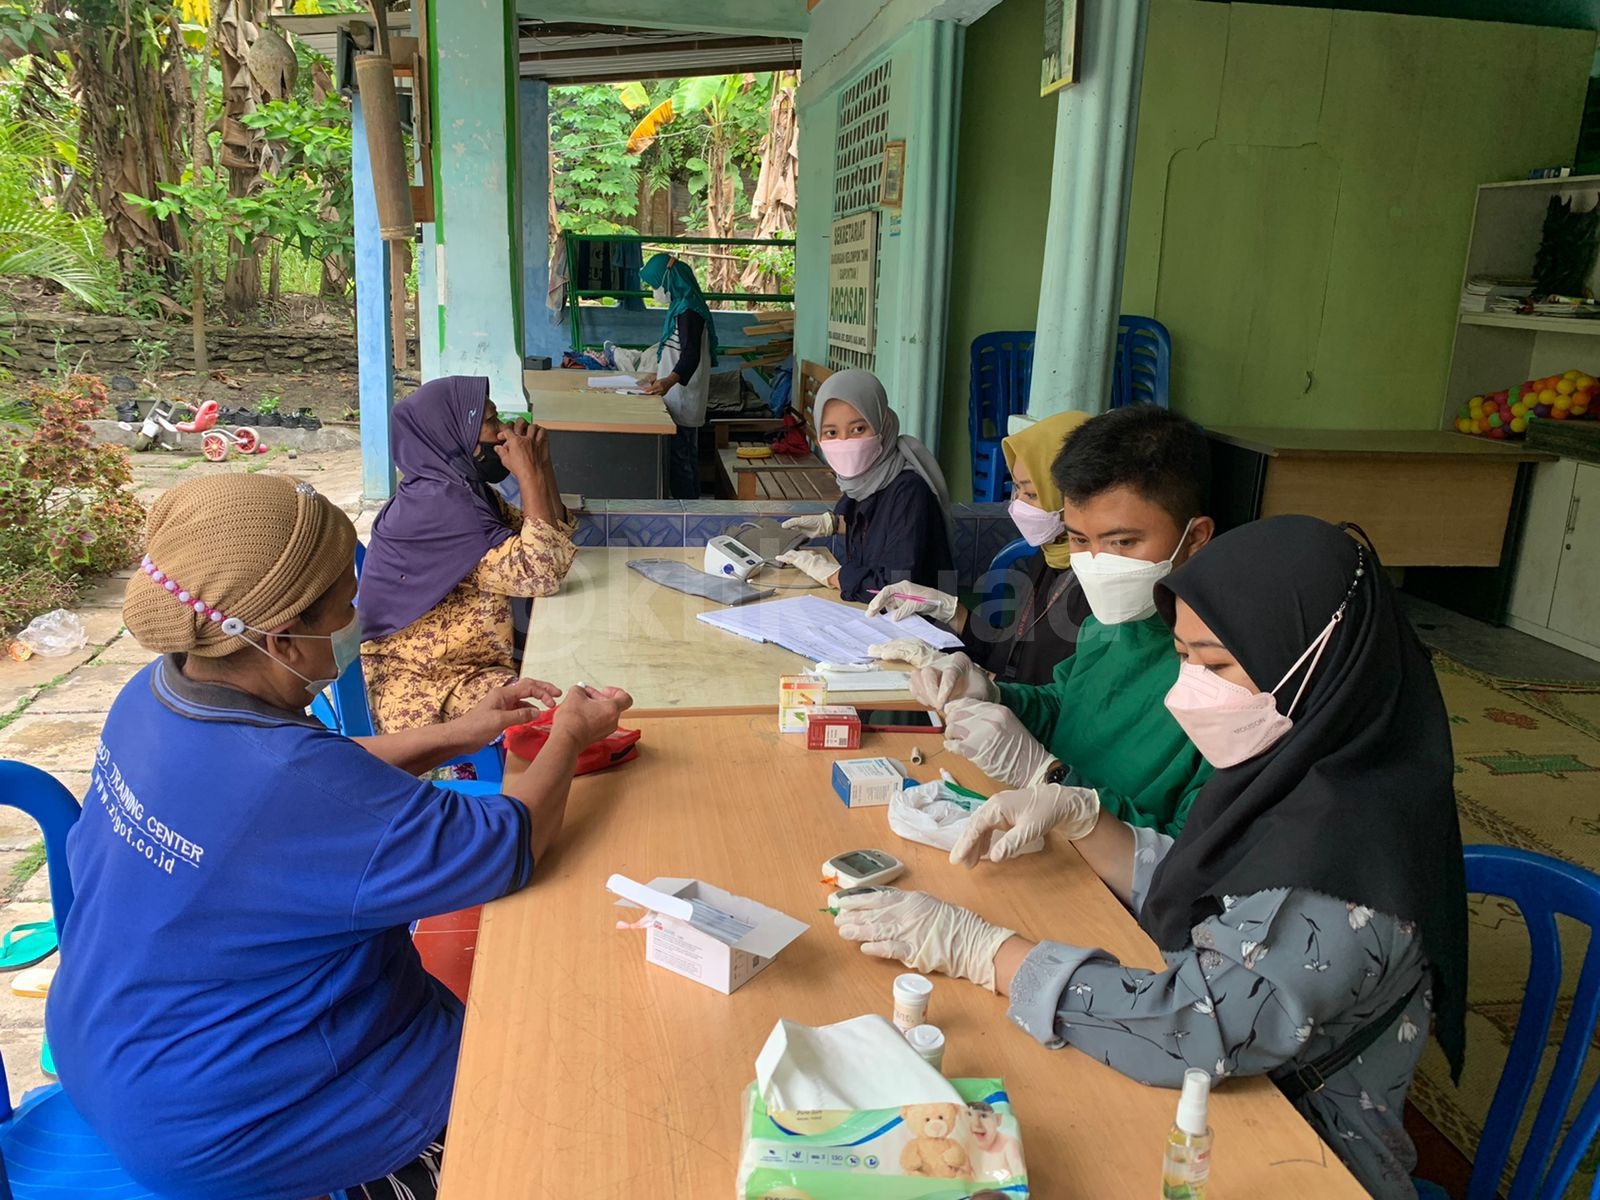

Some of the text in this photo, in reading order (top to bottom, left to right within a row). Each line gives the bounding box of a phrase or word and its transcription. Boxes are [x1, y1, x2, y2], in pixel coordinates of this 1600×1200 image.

[830, 287, 867, 325] ARGOSARI
[109, 762, 145, 821] TRAINING
[147, 815, 204, 863] CENTER
